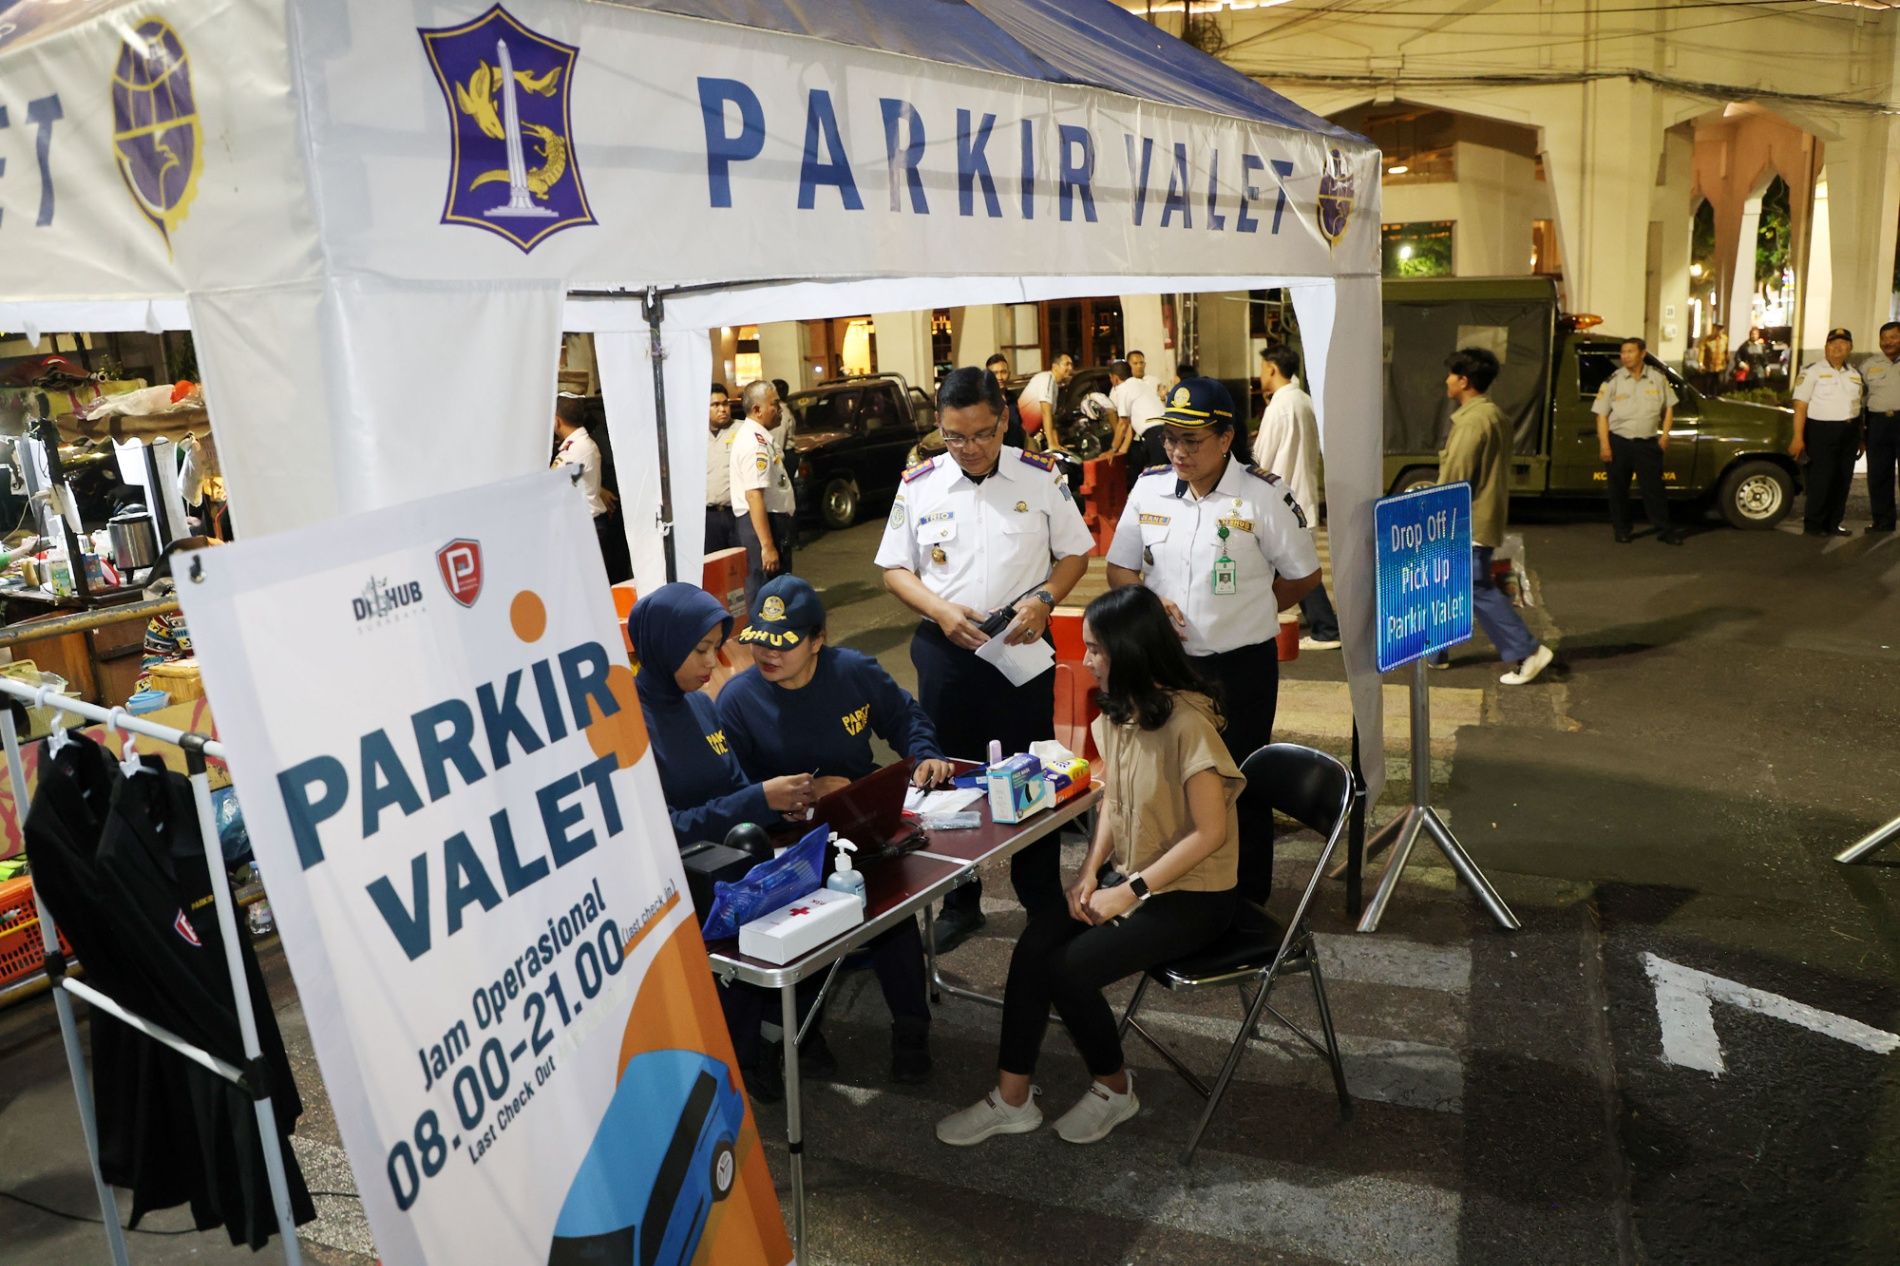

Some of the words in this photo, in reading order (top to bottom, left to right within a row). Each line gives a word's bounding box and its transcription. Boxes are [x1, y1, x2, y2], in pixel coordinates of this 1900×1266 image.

[697, 77, 1097, 223] PARKIR
[1123, 134, 1293, 235] VALET
[1391, 523, 1422, 553] Drop
[1427, 510, 1447, 542] Off
[1402, 561, 1429, 594] Pick
[1434, 557, 1450, 588] Up
[1387, 604, 1427, 643] Parkir
[1432, 591, 1464, 626] Valet
[276, 641, 622, 872] PARKIR
[365, 751, 624, 962] VALET
[641, 895, 666, 925] check
[419, 1019, 471, 1091] Jam
[472, 877, 606, 1030] Operasional
[468, 1123, 497, 1165] Last
[496, 1081, 535, 1130] Check
[535, 1056, 557, 1094] Out
